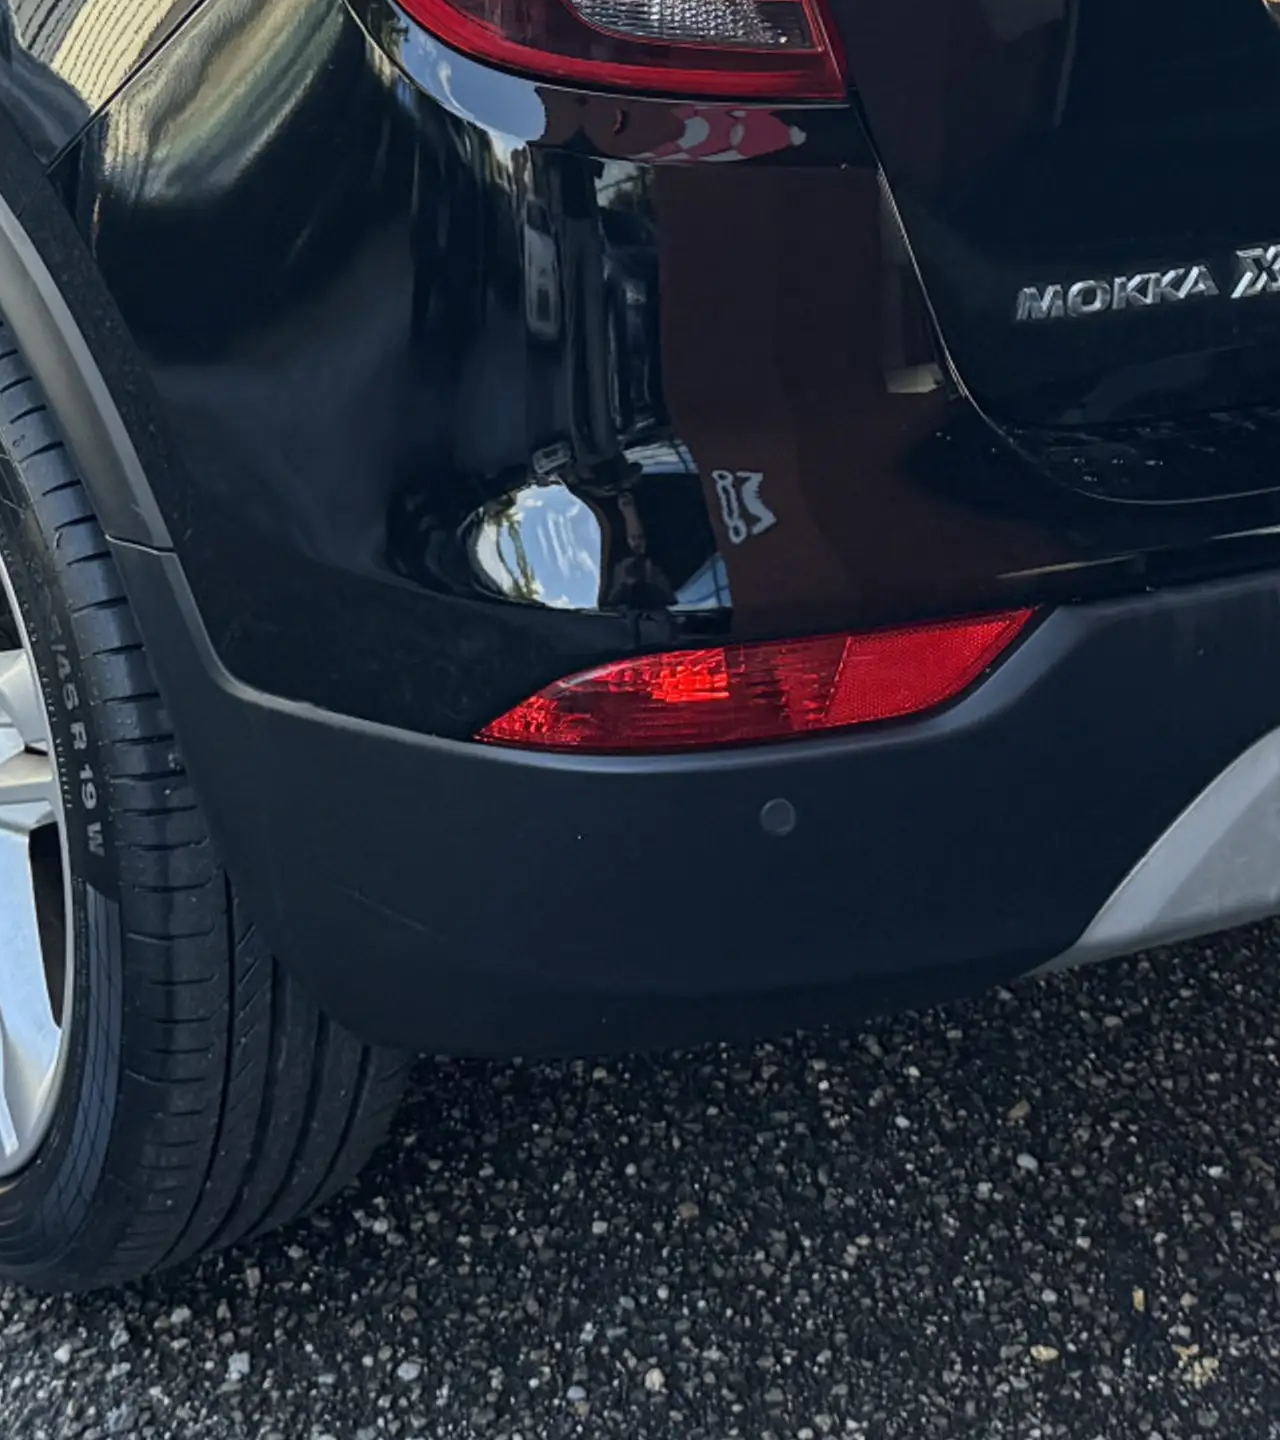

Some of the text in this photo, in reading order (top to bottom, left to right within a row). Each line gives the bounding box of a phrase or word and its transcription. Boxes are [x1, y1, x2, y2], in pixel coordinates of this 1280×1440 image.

[1016, 264, 1219, 320] MOKKA
[70, 721, 88, 750] R
[79, 763, 98, 809] 19
[86, 821, 105, 858] W
